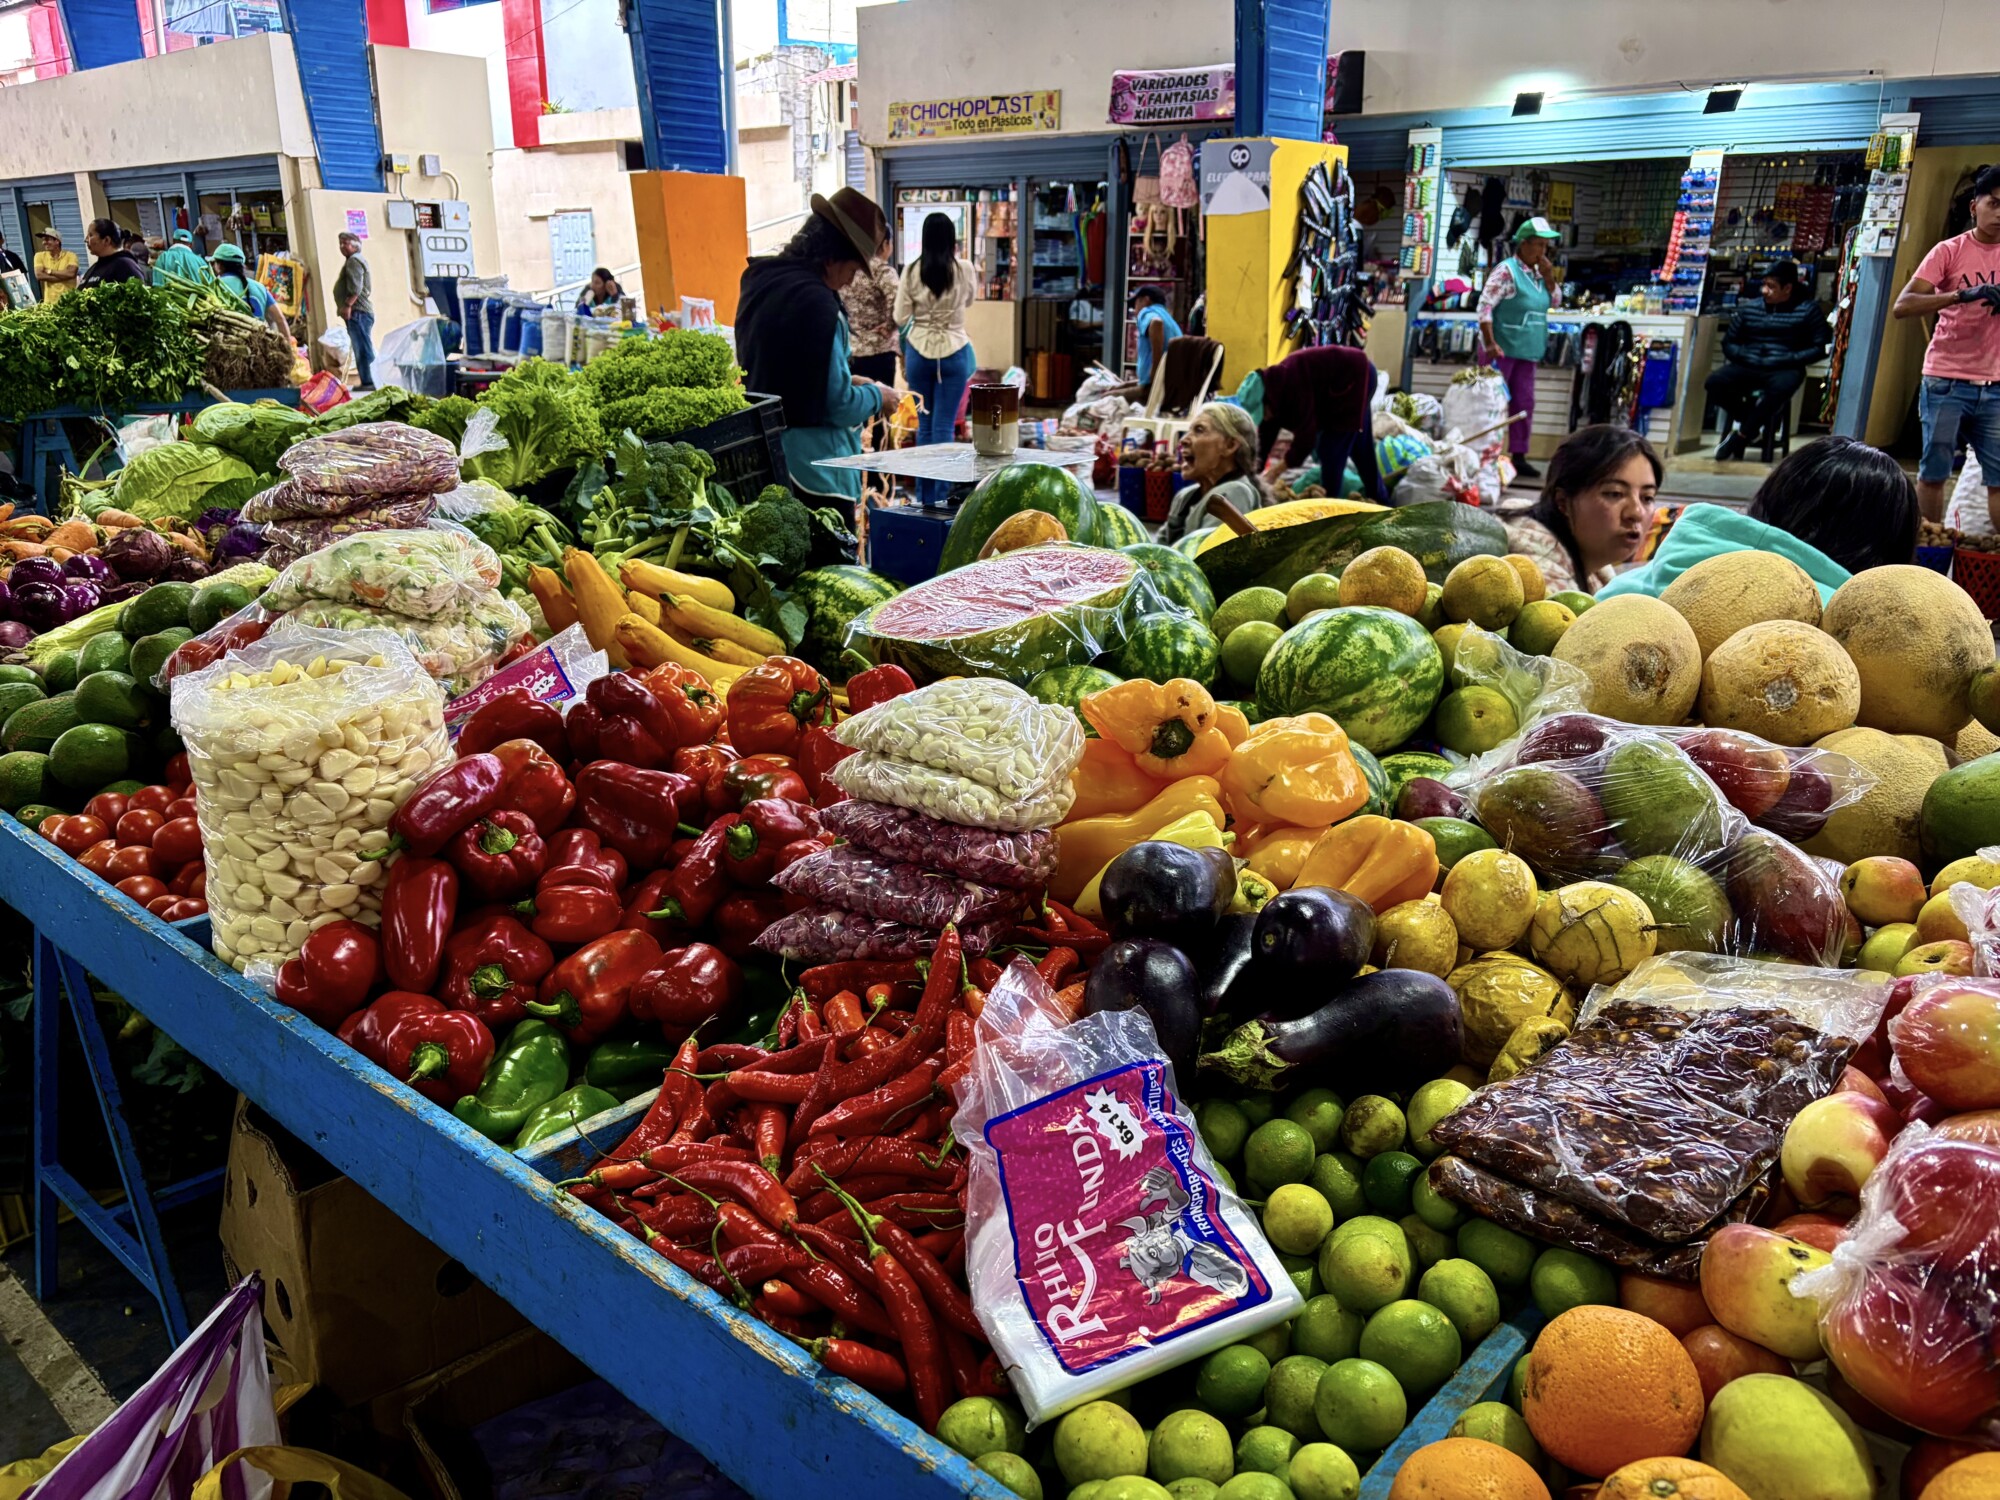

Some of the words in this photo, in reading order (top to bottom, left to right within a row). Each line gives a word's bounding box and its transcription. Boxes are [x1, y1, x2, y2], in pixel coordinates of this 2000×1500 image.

[1132, 74, 1209, 91] VARIEDADES
[1137, 94, 1145, 106] Y
[1147, 88, 1219, 105] FANTASIAS
[910, 95, 1033, 121] CHICHOPLAST
[1135, 105, 1194, 120] XIMENITA
[953, 118, 975, 130] Todo
[977, 119, 989, 129] en
[1957, 270, 2000, 289] AM
[1099, 1103, 1134, 1145] 6x14
[1056, 1113, 1108, 1249] FUNDA
[1171, 1137, 1215, 1238] TRANSPARENTES
